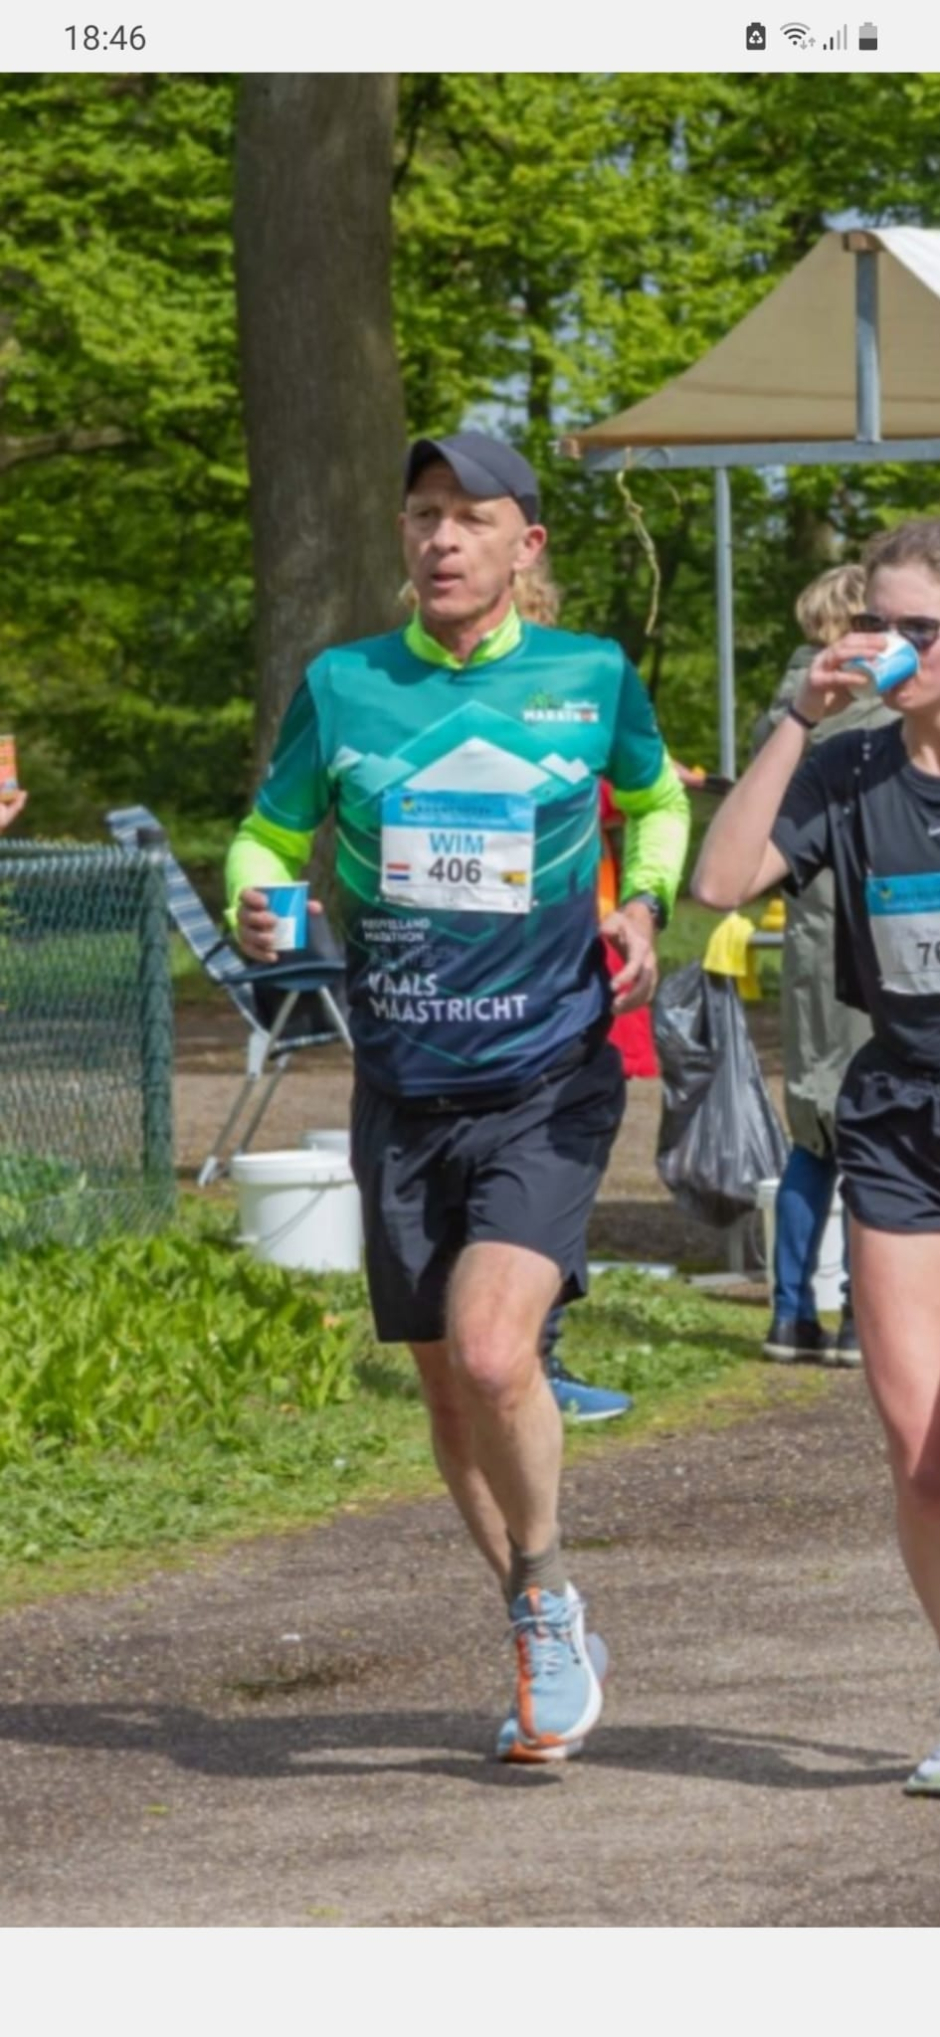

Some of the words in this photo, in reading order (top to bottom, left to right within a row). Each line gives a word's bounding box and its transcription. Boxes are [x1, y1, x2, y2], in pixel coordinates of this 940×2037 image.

[428, 831, 485, 855] WIM
[428, 856, 483, 884] 406
[368, 972, 438, 998] VAALS
[368, 994, 528, 1025] MAASTRICHT
